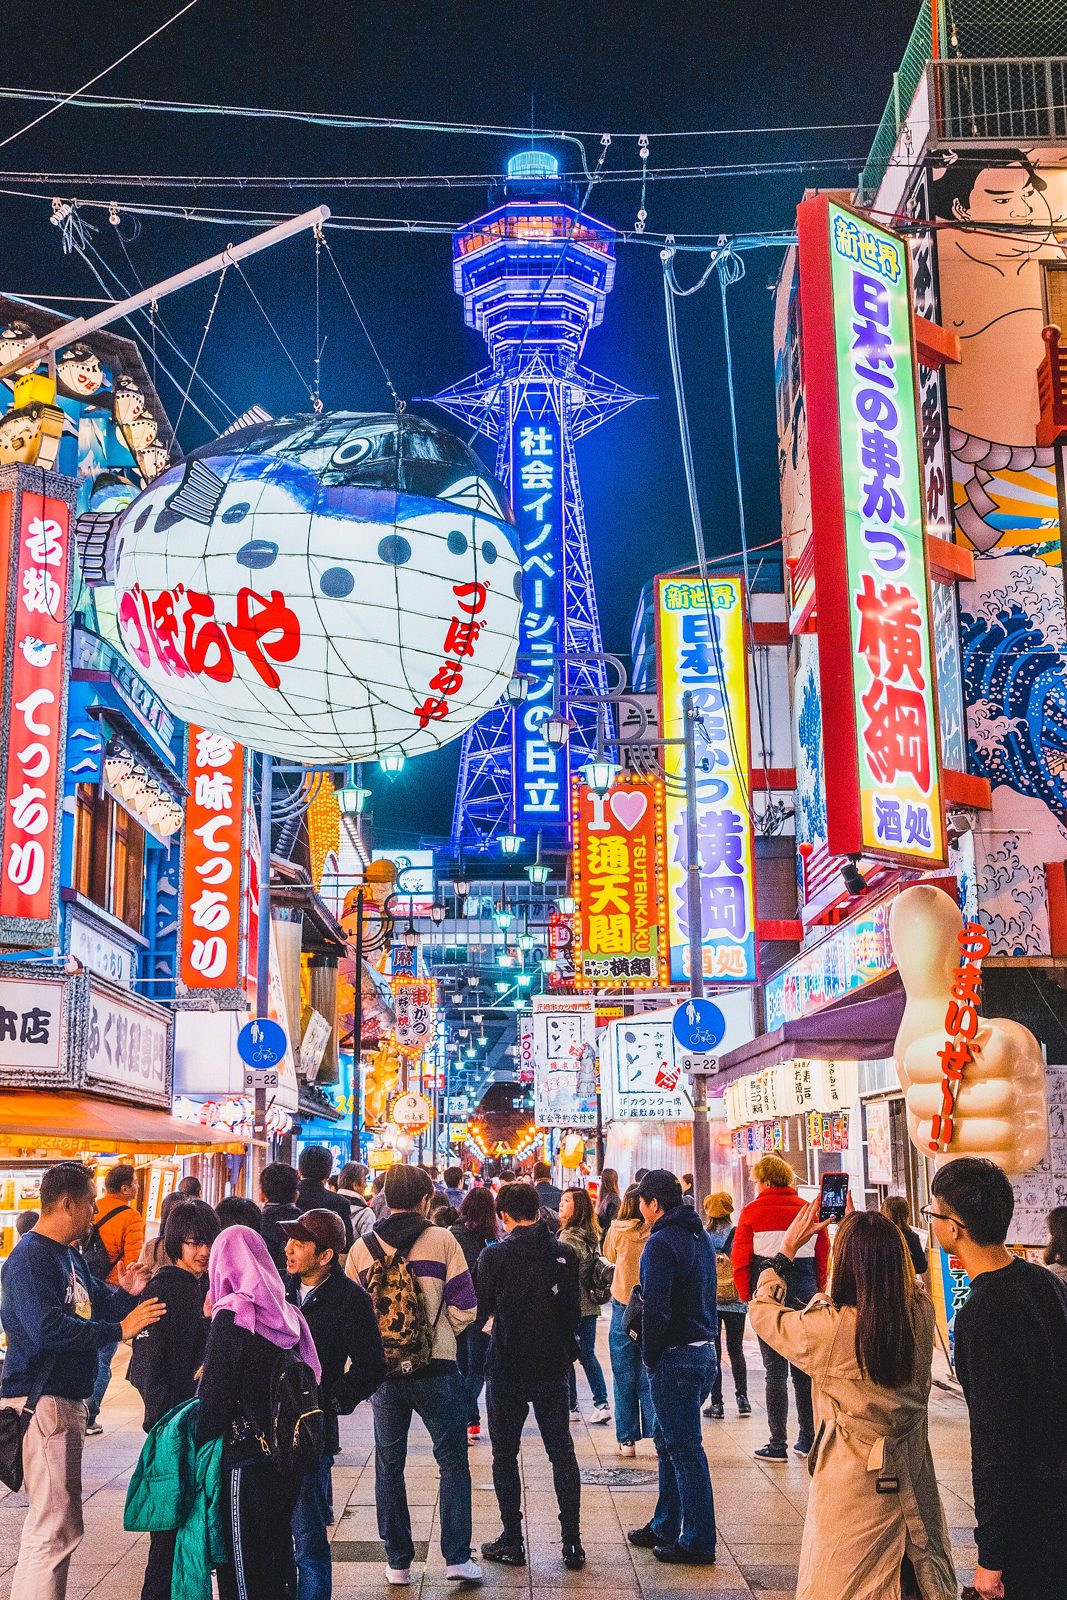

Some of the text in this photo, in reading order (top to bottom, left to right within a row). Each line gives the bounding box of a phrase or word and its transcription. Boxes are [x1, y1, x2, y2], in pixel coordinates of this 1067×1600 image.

[834, 215, 900, 283] 新世界
[852, 271, 906, 572] 日本一の串かつ
[22, 517, 63, 615] 名物
[665, 584, 735, 611] 新世界
[120, 582, 300, 689] づぼらや
[520, 427, 561, 812] 社会イノベーションの日立
[414, 580, 491, 728] づぼらや
[857, 574, 931, 793] 横綱
[8, 688, 55, 896] てっちり
[586, 792, 611, 831] I
[877, 796, 932, 848] 酒処
[189, 729, 236, 979] 珍味てっちり
[587, 835, 632, 953] 通天閣
[633, 835, 650, 951] TSUTENKAKU
[584, 960, 609, 968] 日本一の
[584, 968, 609, 977] 串かつ
[609, 957, 651, 978] 横綱
[397, 987, 410, 1035] お好み焼き
[411, 986, 430, 1036] 串かつ
[538, 1113, 595, 1123] 宴会予約受付中
[630, 1098, 682, 1106] カウンター席
